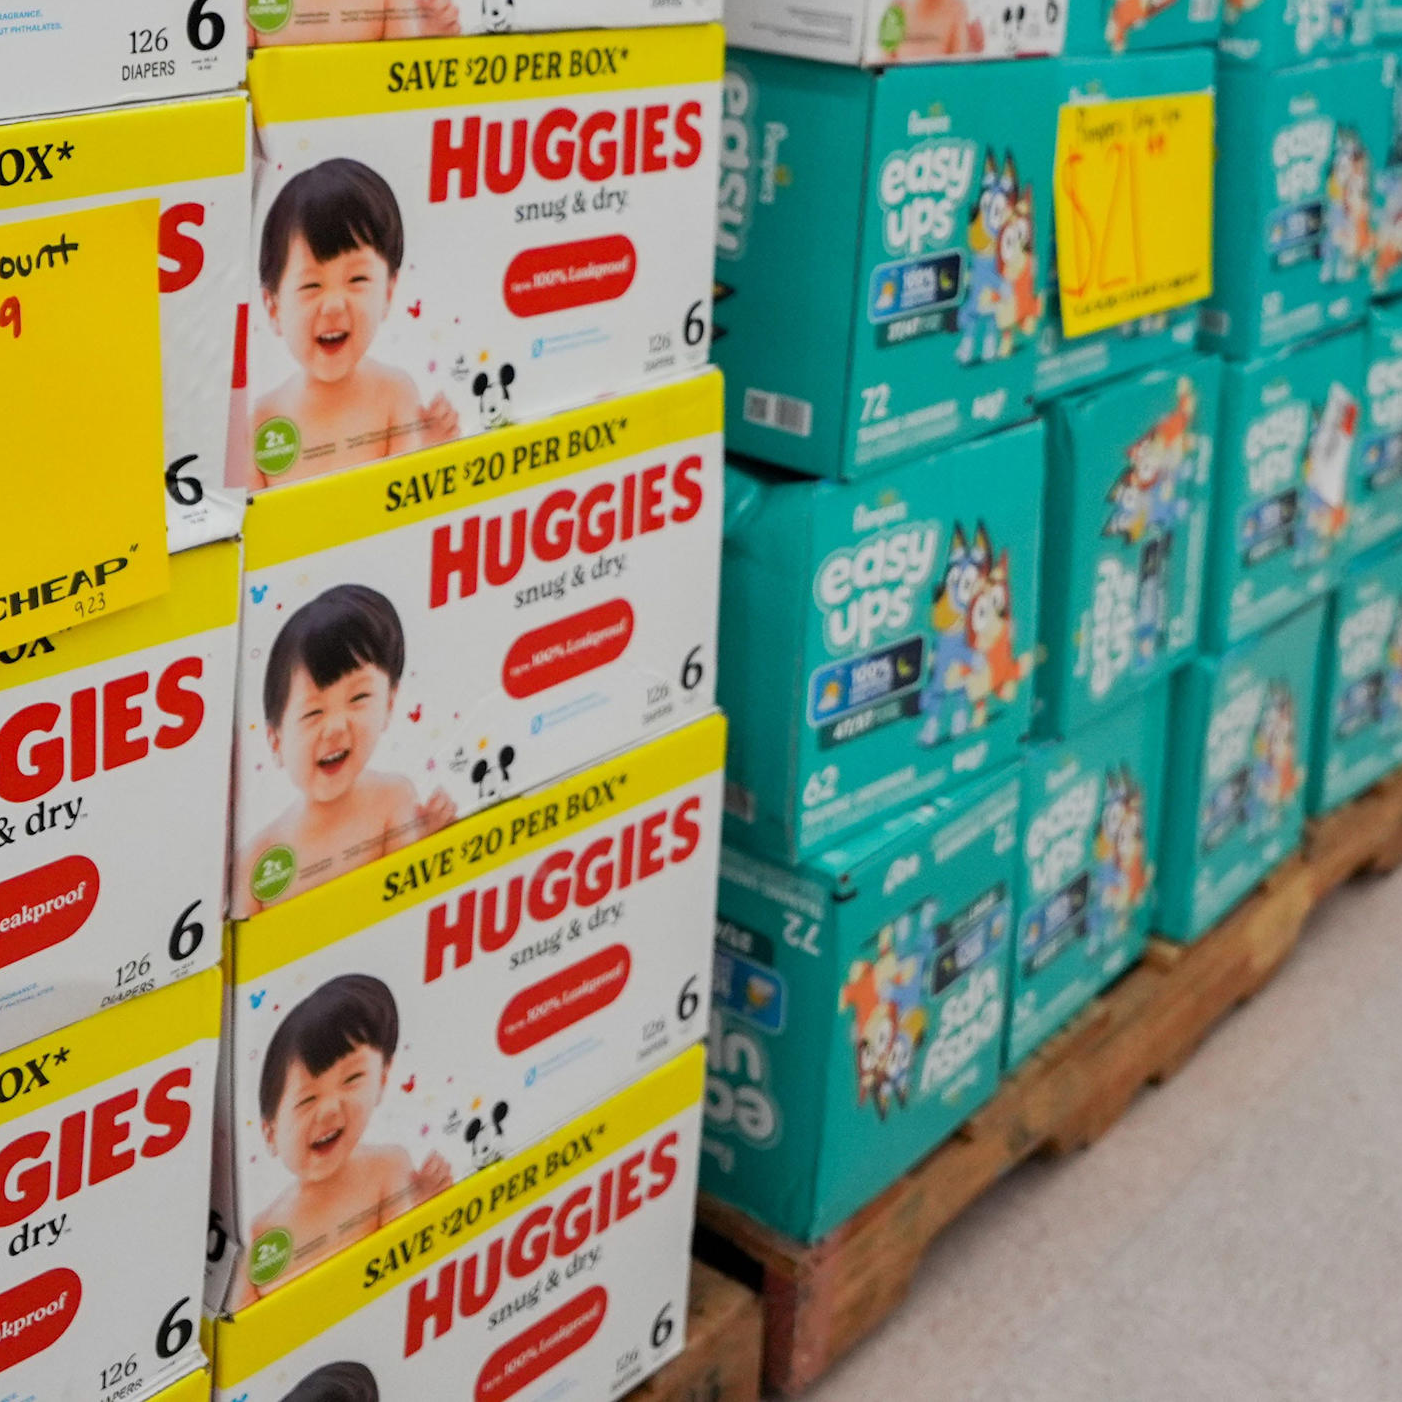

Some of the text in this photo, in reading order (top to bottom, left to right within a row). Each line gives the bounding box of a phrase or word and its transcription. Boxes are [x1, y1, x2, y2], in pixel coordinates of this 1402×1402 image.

[129, 27, 168, 56] 126
[122, 60, 176, 82] DIAPERS
[387, 57, 459, 94] SAVE
[465, 55, 509, 87] $20
[514, 51, 562, 82] PER
[428, 100, 702, 204] HUGGIES
[881, 145, 975, 205] easy
[886, 198, 956, 254] ups
[683, 300, 704, 347] 6
[429, 454, 704, 609] HUGGIES
[819, 527, 936, 598] easy
[74, 592, 106, 619] 923
[827, 586, 911, 651] ups
[681, 644, 704, 691] 6
[802, 765, 839, 807] 62
[423, 796, 701, 984] HUGGIES
[168, 899, 204, 962] 6
[114, 952, 151, 988] 126
[403, 1130, 680, 1360] HUGGIES
[156, 1295, 194, 1359] 6
[99, 1355, 139, 1391] 126
